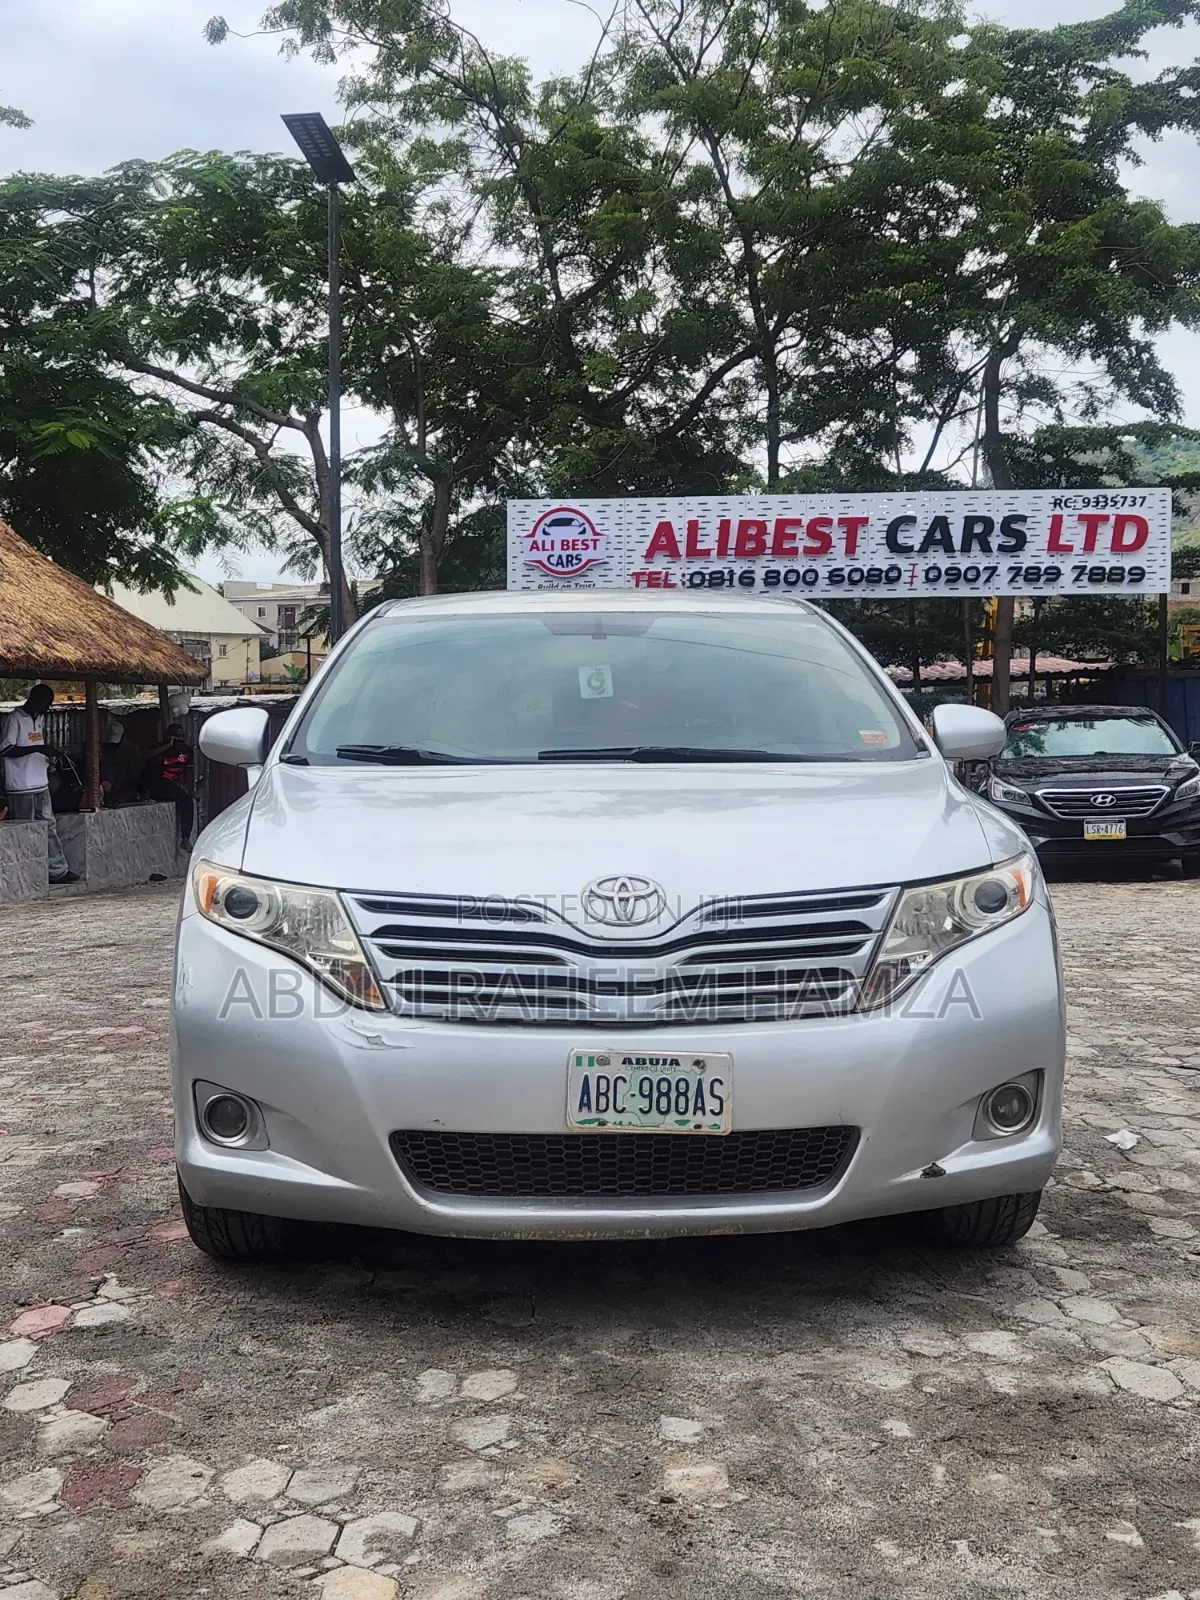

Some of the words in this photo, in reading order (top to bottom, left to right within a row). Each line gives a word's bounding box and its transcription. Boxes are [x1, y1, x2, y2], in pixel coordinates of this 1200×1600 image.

[1081, 495, 1147, 508] 9335737
[644, 516, 869, 560] ALIBEST
[885, 514, 1028, 554] CARS
[1046, 513, 1150, 554] LTD
[529, 539, 555, 552] ALI
[560, 538, 600, 551] BEST
[547, 553, 583, 568] CARS
[688, 569, 756, 588] 0816
[763, 568, 820, 587] 800
[828, 566, 902, 585] 6080
[923, 565, 999, 584] 0907
[1006, 565, 1062, 584] 789
[1071, 564, 1147, 583] 7889
[621, 1057, 681, 1066] ABUJA
